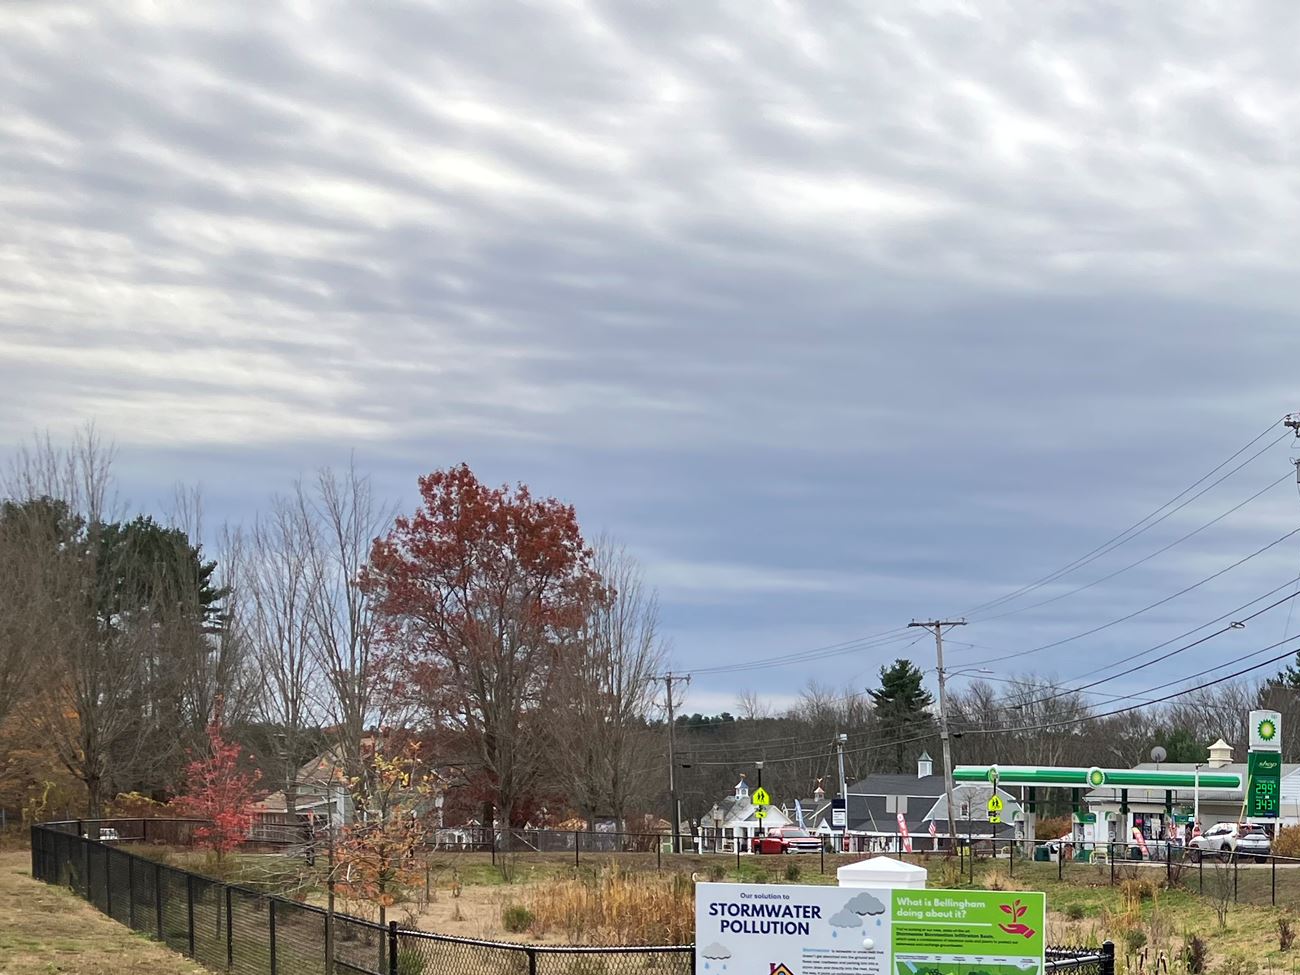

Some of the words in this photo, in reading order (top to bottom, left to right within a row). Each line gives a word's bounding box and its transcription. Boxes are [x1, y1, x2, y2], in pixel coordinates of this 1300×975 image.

[754, 892, 782, 900] solution
[896, 896, 922, 906] What
[924, 898, 931, 907] is
[934, 898, 986, 909] Bellingham
[709, 903, 822, 919] STORMWATER
[896, 908, 923, 919] doing
[925, 909, 953, 918] about
[954, 910, 967, 918] it?
[720, 919, 810, 936] POLLUTION
